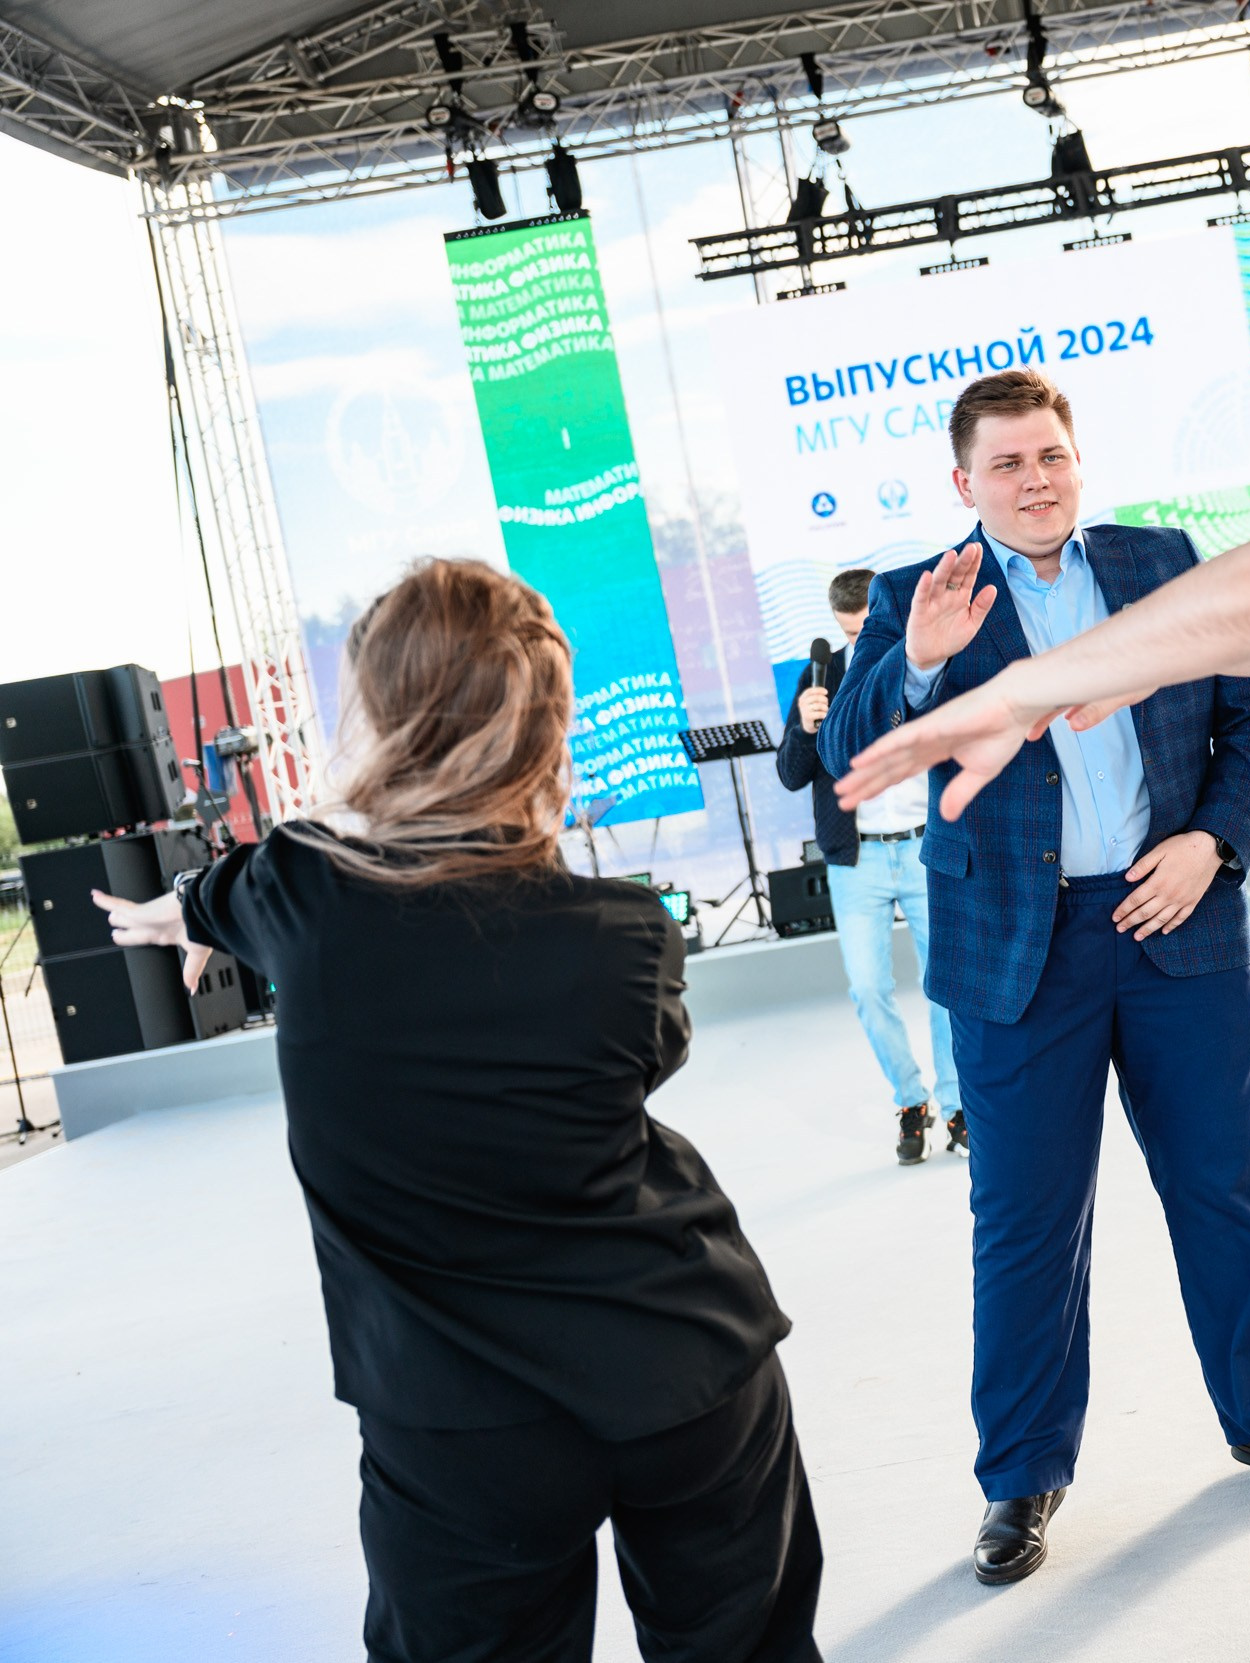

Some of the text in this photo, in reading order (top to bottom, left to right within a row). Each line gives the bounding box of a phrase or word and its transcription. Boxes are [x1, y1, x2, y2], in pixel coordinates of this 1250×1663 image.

[508, 252, 592, 288] ФИЗИКА
[469, 273, 596, 322] МАТЕМАТИКА
[520, 314, 604, 350] ФИЗИКА
[784, 316, 1155, 407] ВЫПУСКНОЙ 2024
[796, 398, 955, 455] МГУ САР
[595, 691, 677, 726] ФИЗИКА
[607, 751, 688, 786] ФИЗИКА
